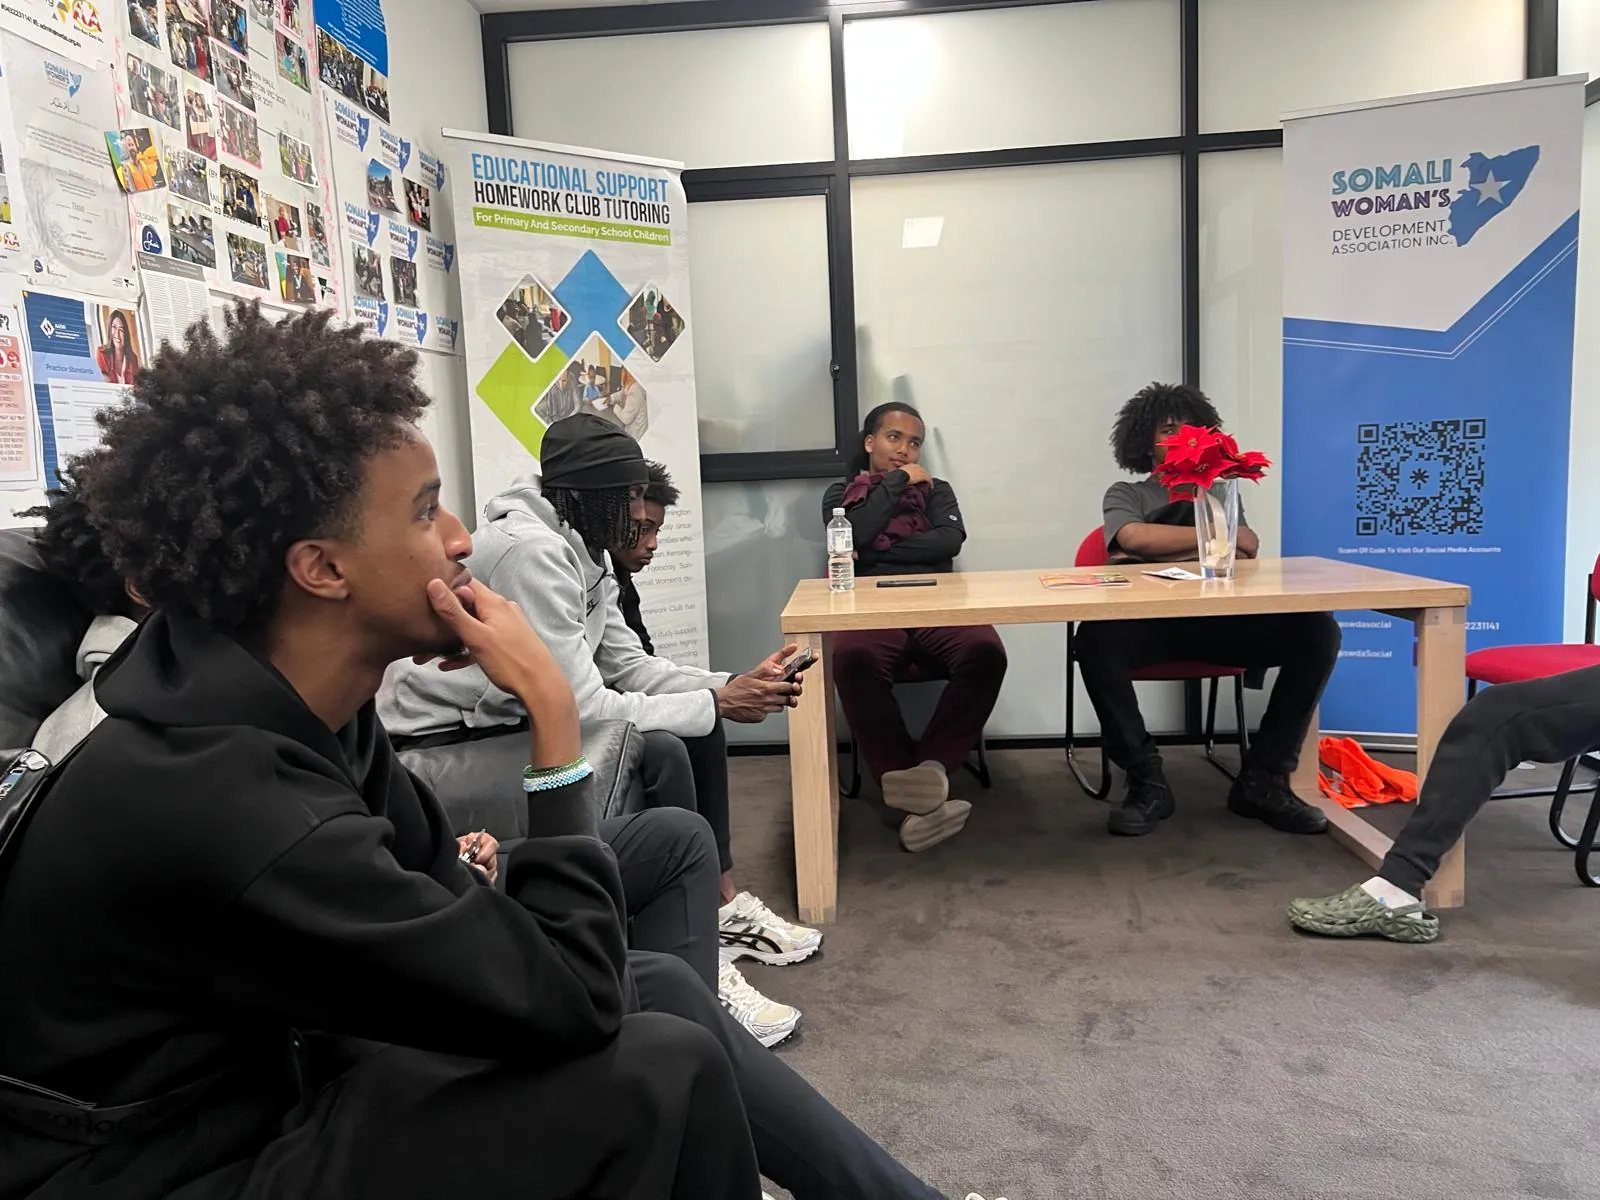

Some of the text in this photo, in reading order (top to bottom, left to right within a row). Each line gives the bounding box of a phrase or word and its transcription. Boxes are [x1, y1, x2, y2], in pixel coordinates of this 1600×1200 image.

[472, 153, 592, 194] EDUCATIONAL
[596, 170, 668, 203] SUPPORT
[1332, 158, 1452, 195] SOMALI
[474, 181, 670, 225] HOMEWORK CLUB TUTORING
[1331, 188, 1451, 217] WOMAN'S
[476, 211, 669, 242] For Primary And Secondary School Children
[1333, 219, 1447, 242] DEVELOPMENT
[1332, 237, 1422, 255] ASSOCIATION
